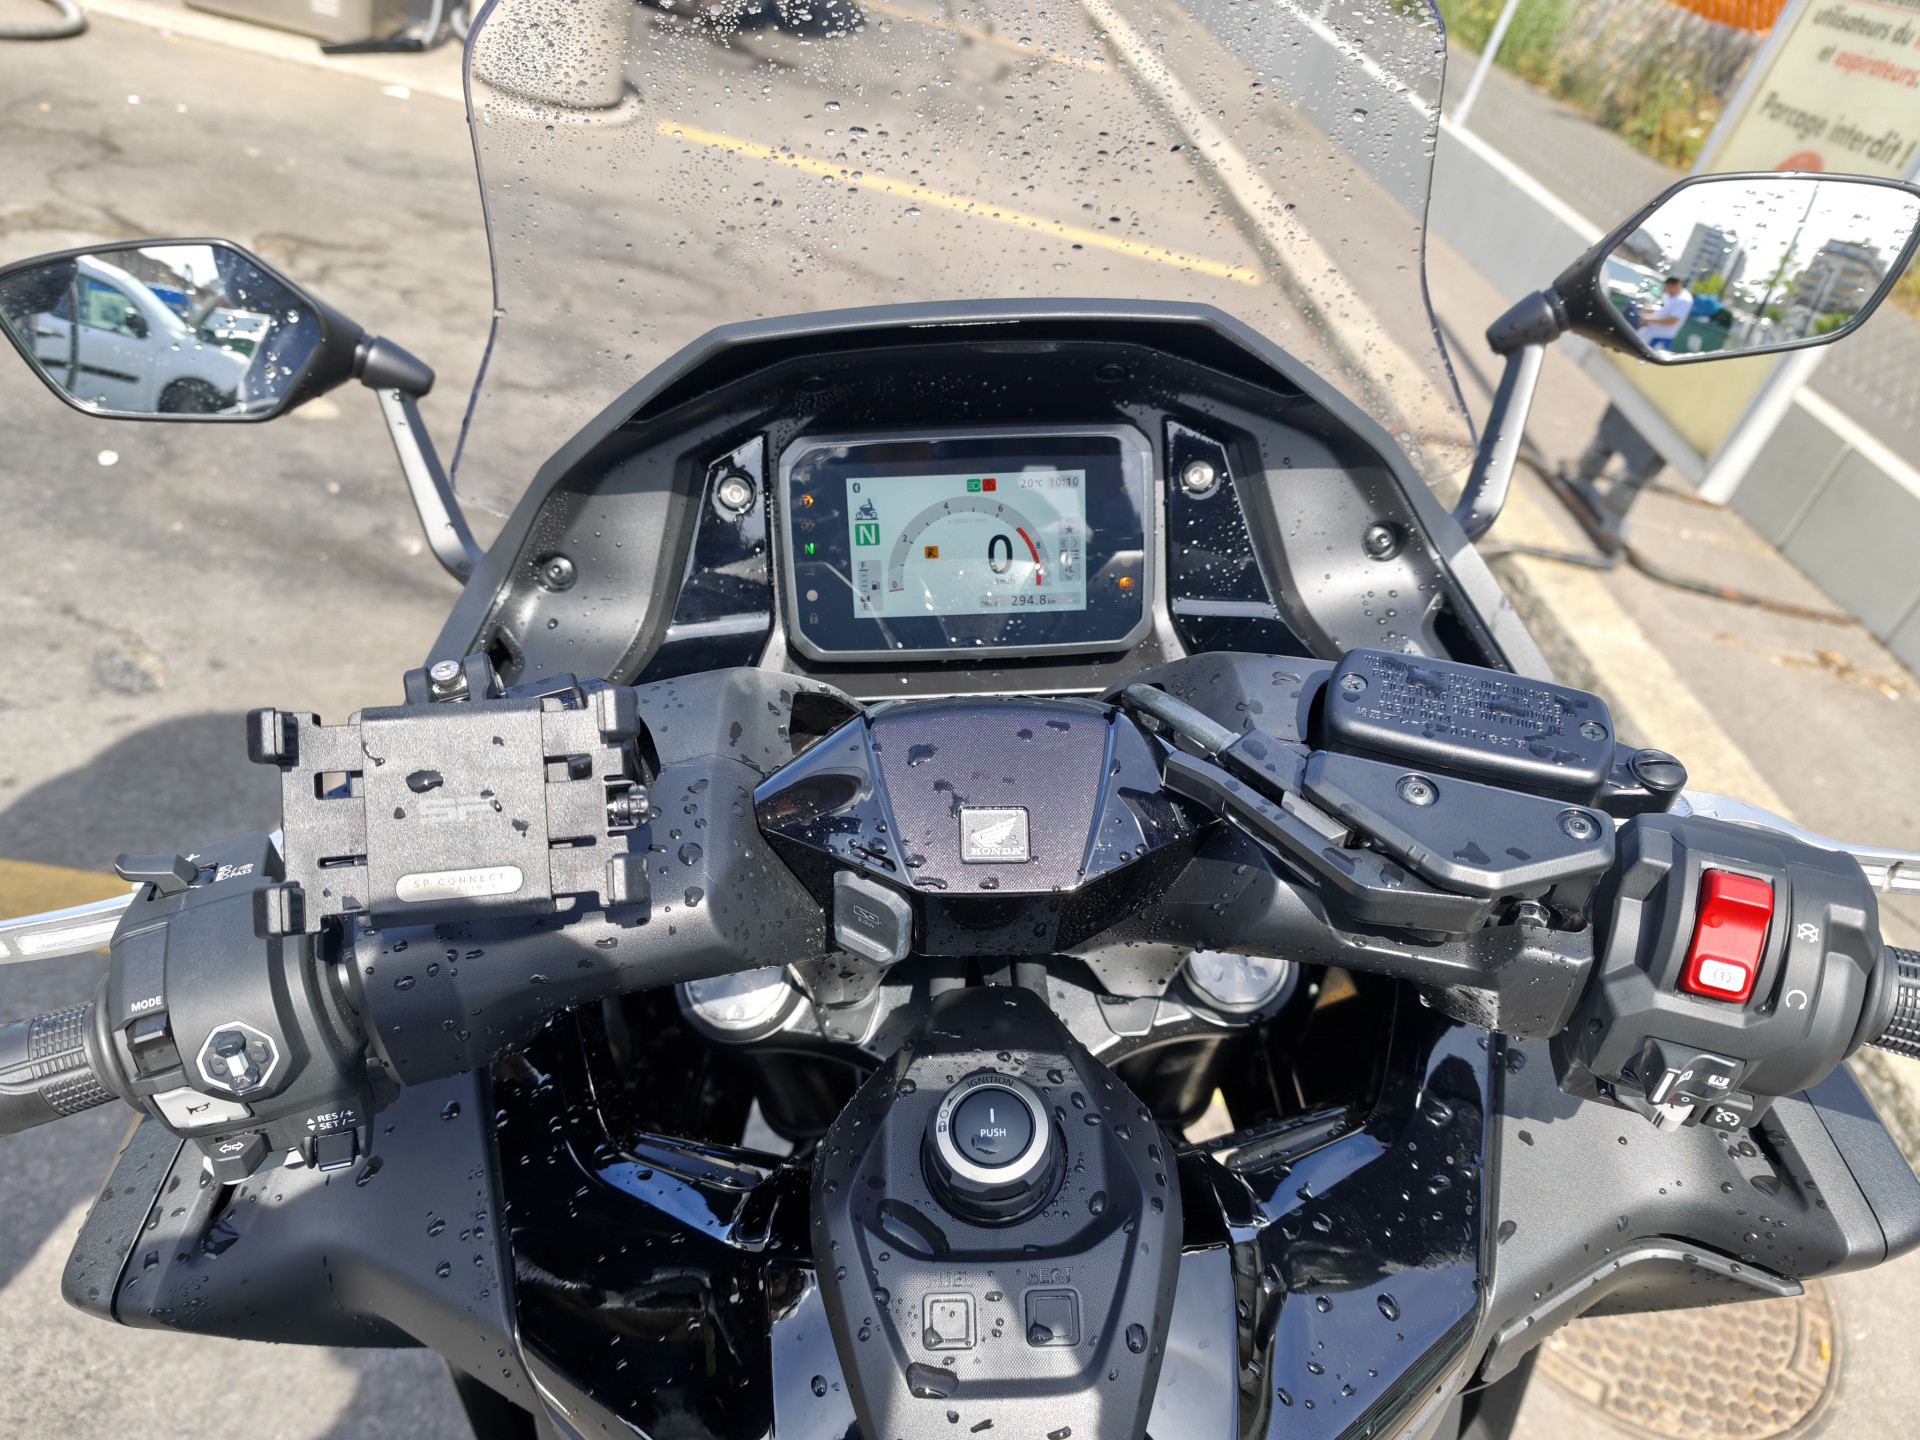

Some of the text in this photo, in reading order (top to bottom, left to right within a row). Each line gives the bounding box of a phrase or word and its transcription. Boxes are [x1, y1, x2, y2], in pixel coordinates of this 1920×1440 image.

[1813, 4, 1893, 40] utilisateurs
[1892, 19, 1917, 45] du
[1818, 44, 1838, 62] et
[1759, 91, 1829, 140] Parcage
[1828, 114, 1906, 164] interdit
[1049, 477, 1079, 487] 10:10
[998, 504, 1004, 512] 6
[859, 525, 876, 545] N
[902, 535, 908, 543] 2
[987, 534, 1013, 575] 0
[892, 581, 897, 589] 0
[994, 577, 1016, 585] km/h
[1011, 595, 1047, 606] 294.8
[1382, 680, 1423, 697] FILLER
[1512, 686, 1550, 701] BRAKE
[1500, 716, 1544, 733] FLUIDE
[970, 846, 1022, 856] HONDA
[438, 873, 505, 887] CONNECT
[131, 995, 162, 1013] MODE
[966, 1075, 1014, 1089] IGNITION
[980, 1127, 1007, 1138] PUSH
[925, 1266, 1074, 1288] FUEL SEAT
